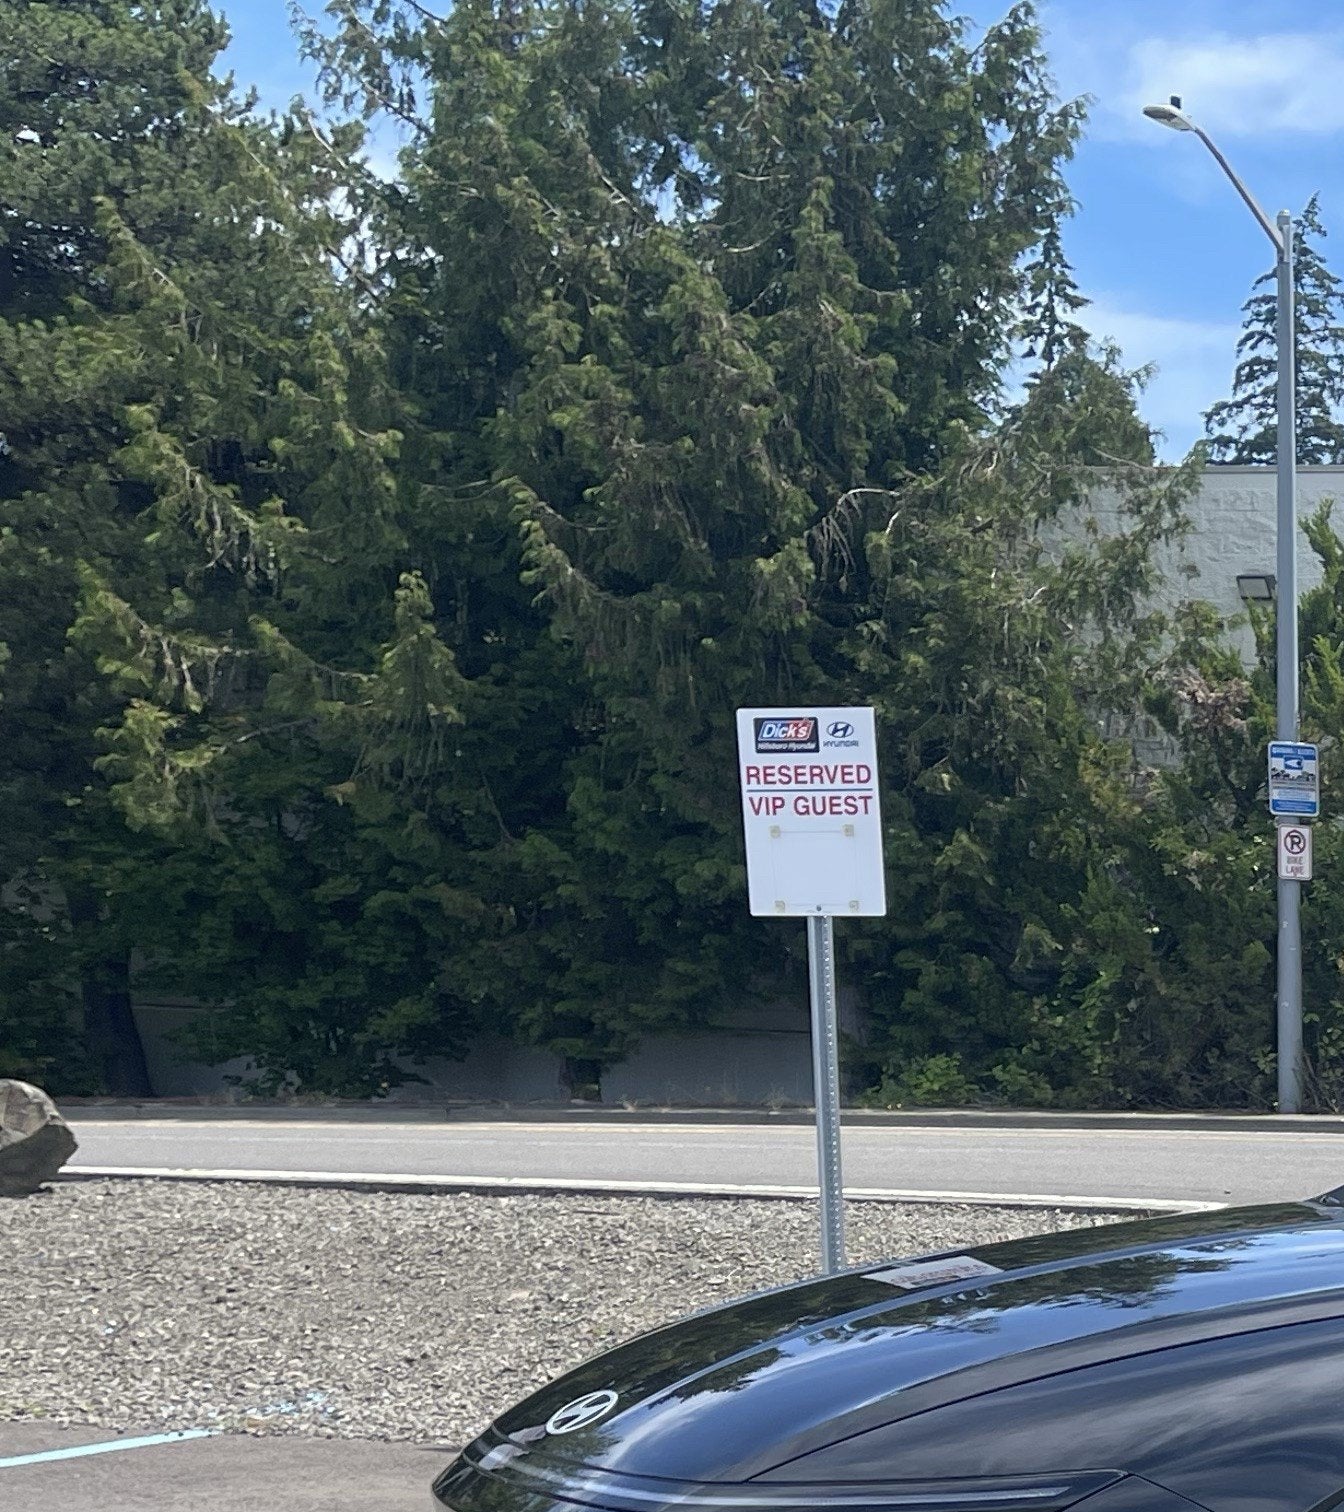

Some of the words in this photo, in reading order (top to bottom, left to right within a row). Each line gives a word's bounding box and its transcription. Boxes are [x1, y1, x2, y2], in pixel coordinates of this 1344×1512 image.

[745, 764, 872, 785] RESERVED
[749, 796, 786, 816] VIP
[793, 795, 873, 815] GUEST
